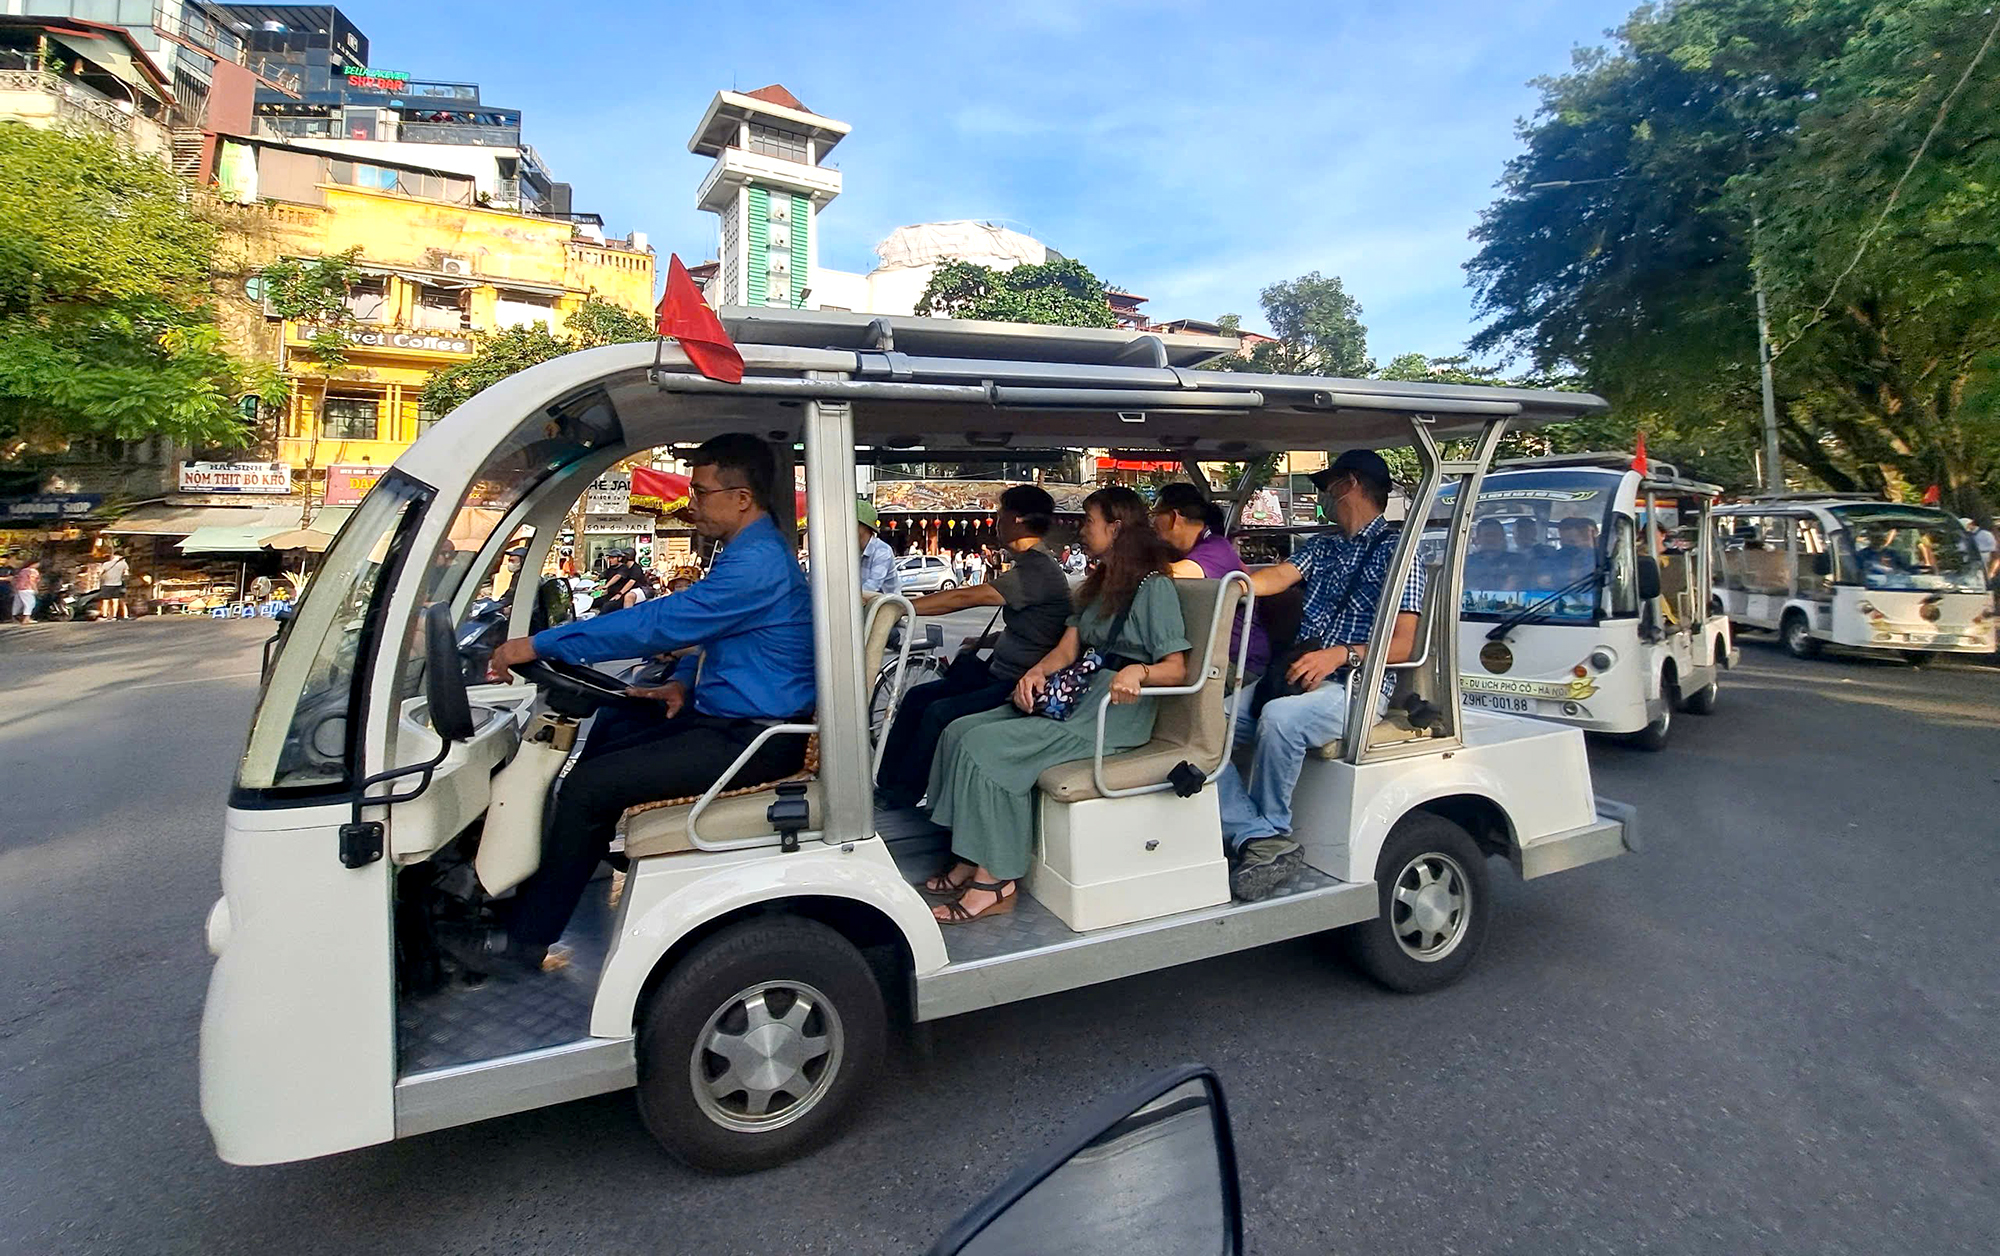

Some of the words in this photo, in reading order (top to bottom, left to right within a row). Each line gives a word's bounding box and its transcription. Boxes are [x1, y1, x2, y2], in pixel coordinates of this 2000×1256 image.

[377, 78, 404, 90] BAR
[394, 334, 467, 351] Coffee
[590, 481, 607, 490] HE
[611, 481, 631, 490] JA
[1462, 694, 1528, 711] 29HC-001.88
